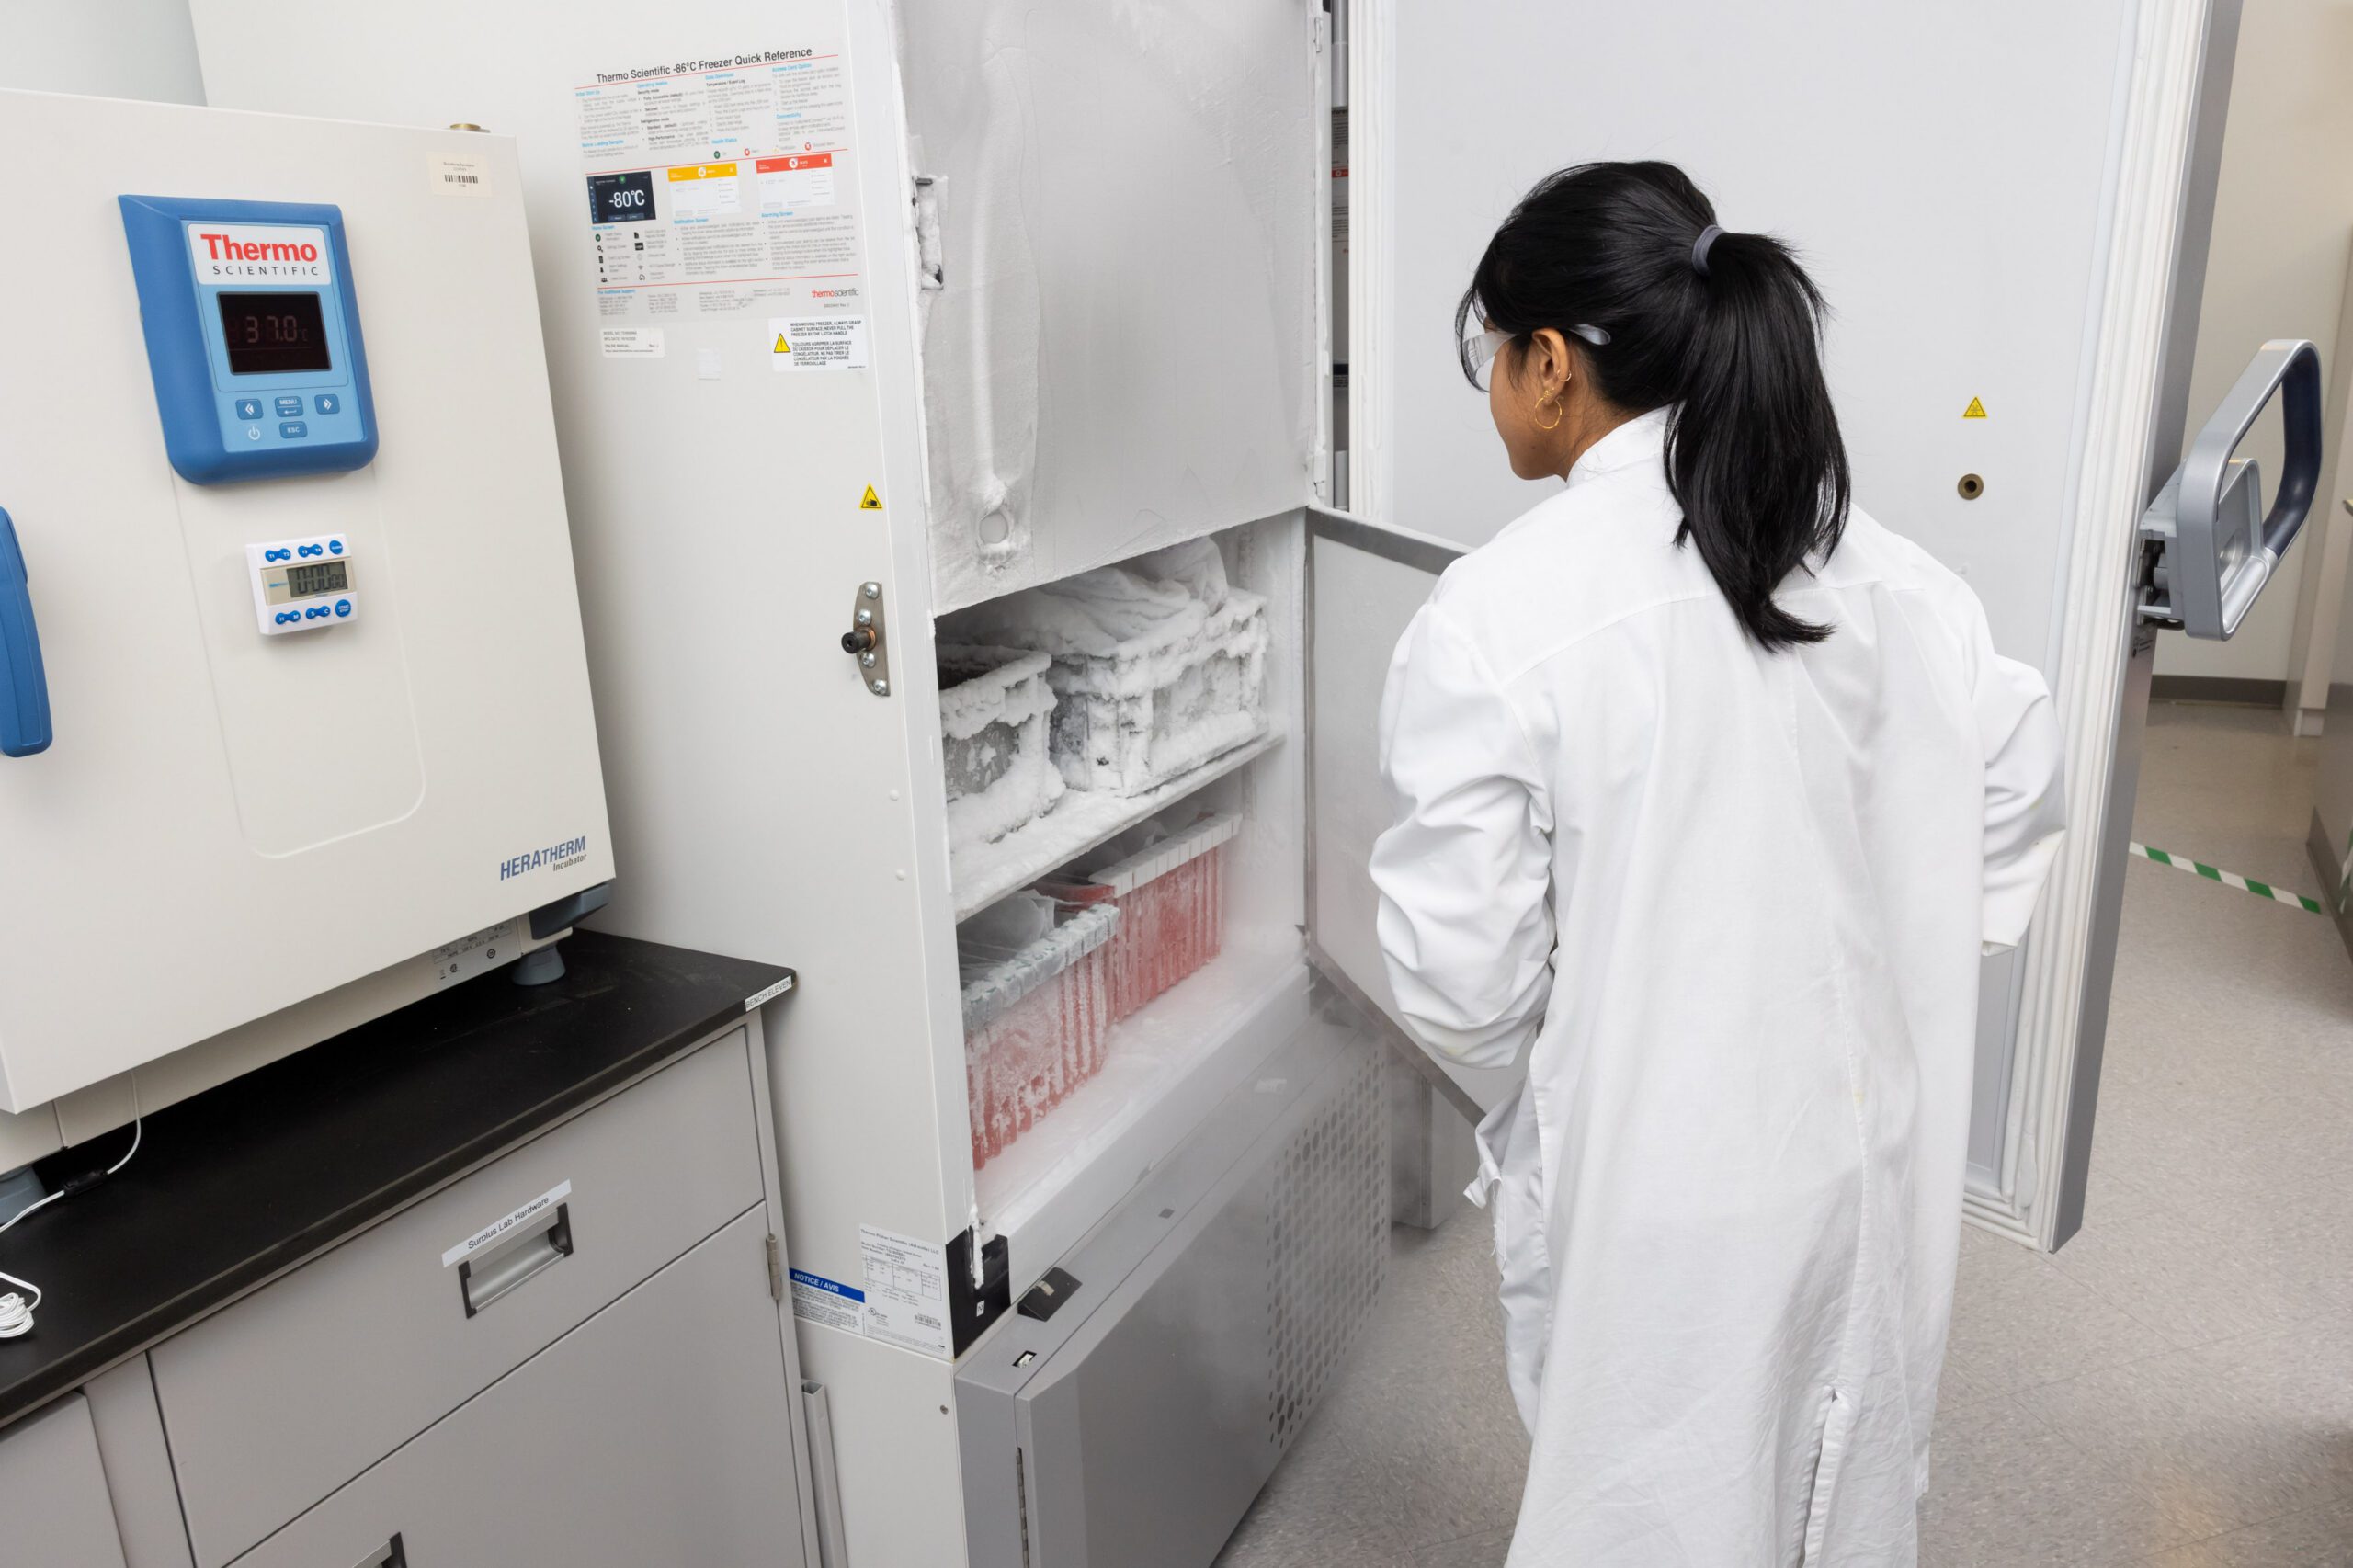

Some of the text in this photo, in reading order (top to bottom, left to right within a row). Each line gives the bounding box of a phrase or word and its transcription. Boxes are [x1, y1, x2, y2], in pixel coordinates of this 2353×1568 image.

[597, 48, 813, 84] Thermo Scientific -86°C Freezer Quick Reference
[608, 189, 645, 208] -80°C
[200, 233, 318, 263] Thermo
[213, 265, 318, 276] SCIENTIFIC
[246, 315, 298, 344] 37.0
[500, 835, 586, 881] HERATHERM
[553, 854, 587, 871] Incubator
[746, 978, 791, 1009] BENCH ELEVEN
[467, 1197, 550, 1250] Surplus Lab Hardware
[794, 1273, 820, 1286] NOTICE
[824, 1282, 839, 1292] AVIS
